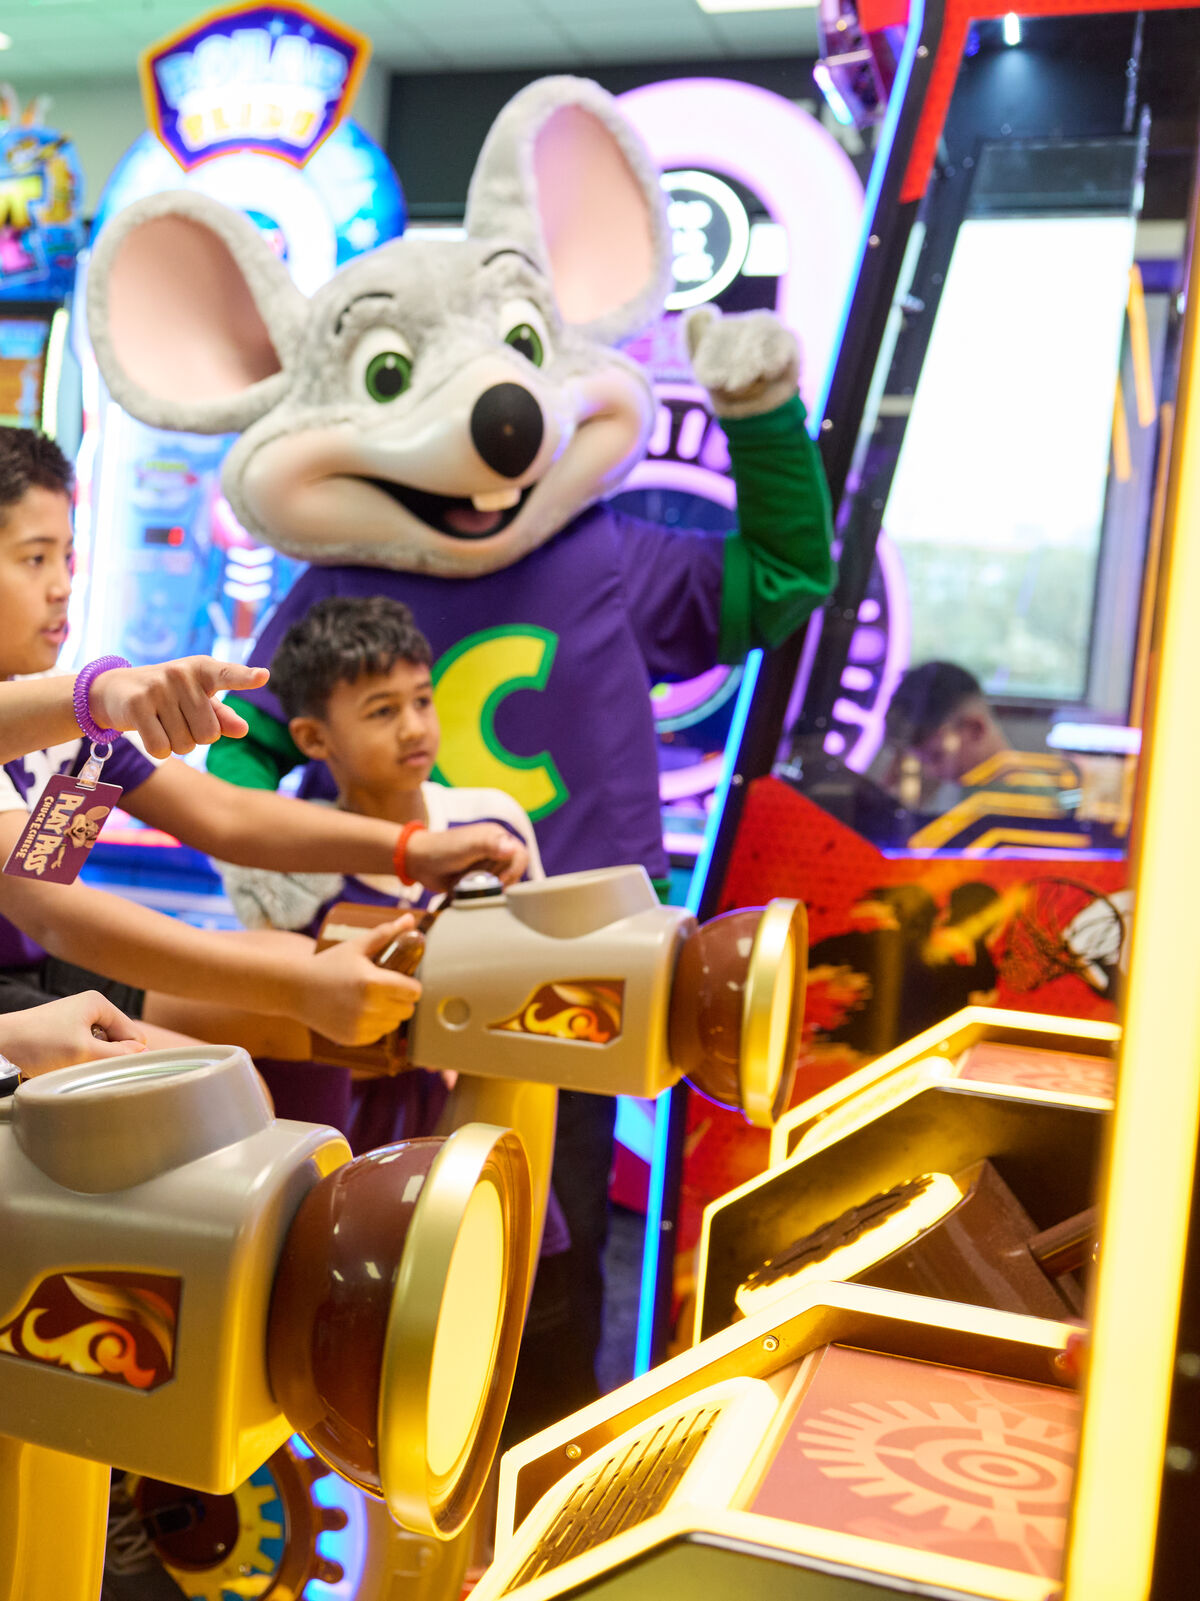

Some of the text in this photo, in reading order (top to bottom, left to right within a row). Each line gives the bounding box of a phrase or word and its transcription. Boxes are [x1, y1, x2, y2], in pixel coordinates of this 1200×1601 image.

[429, 622, 570, 824] C
[35, 796, 55, 823] CHUCK
[42, 791, 86, 836] PLAY
[22, 832, 63, 876] PASS
